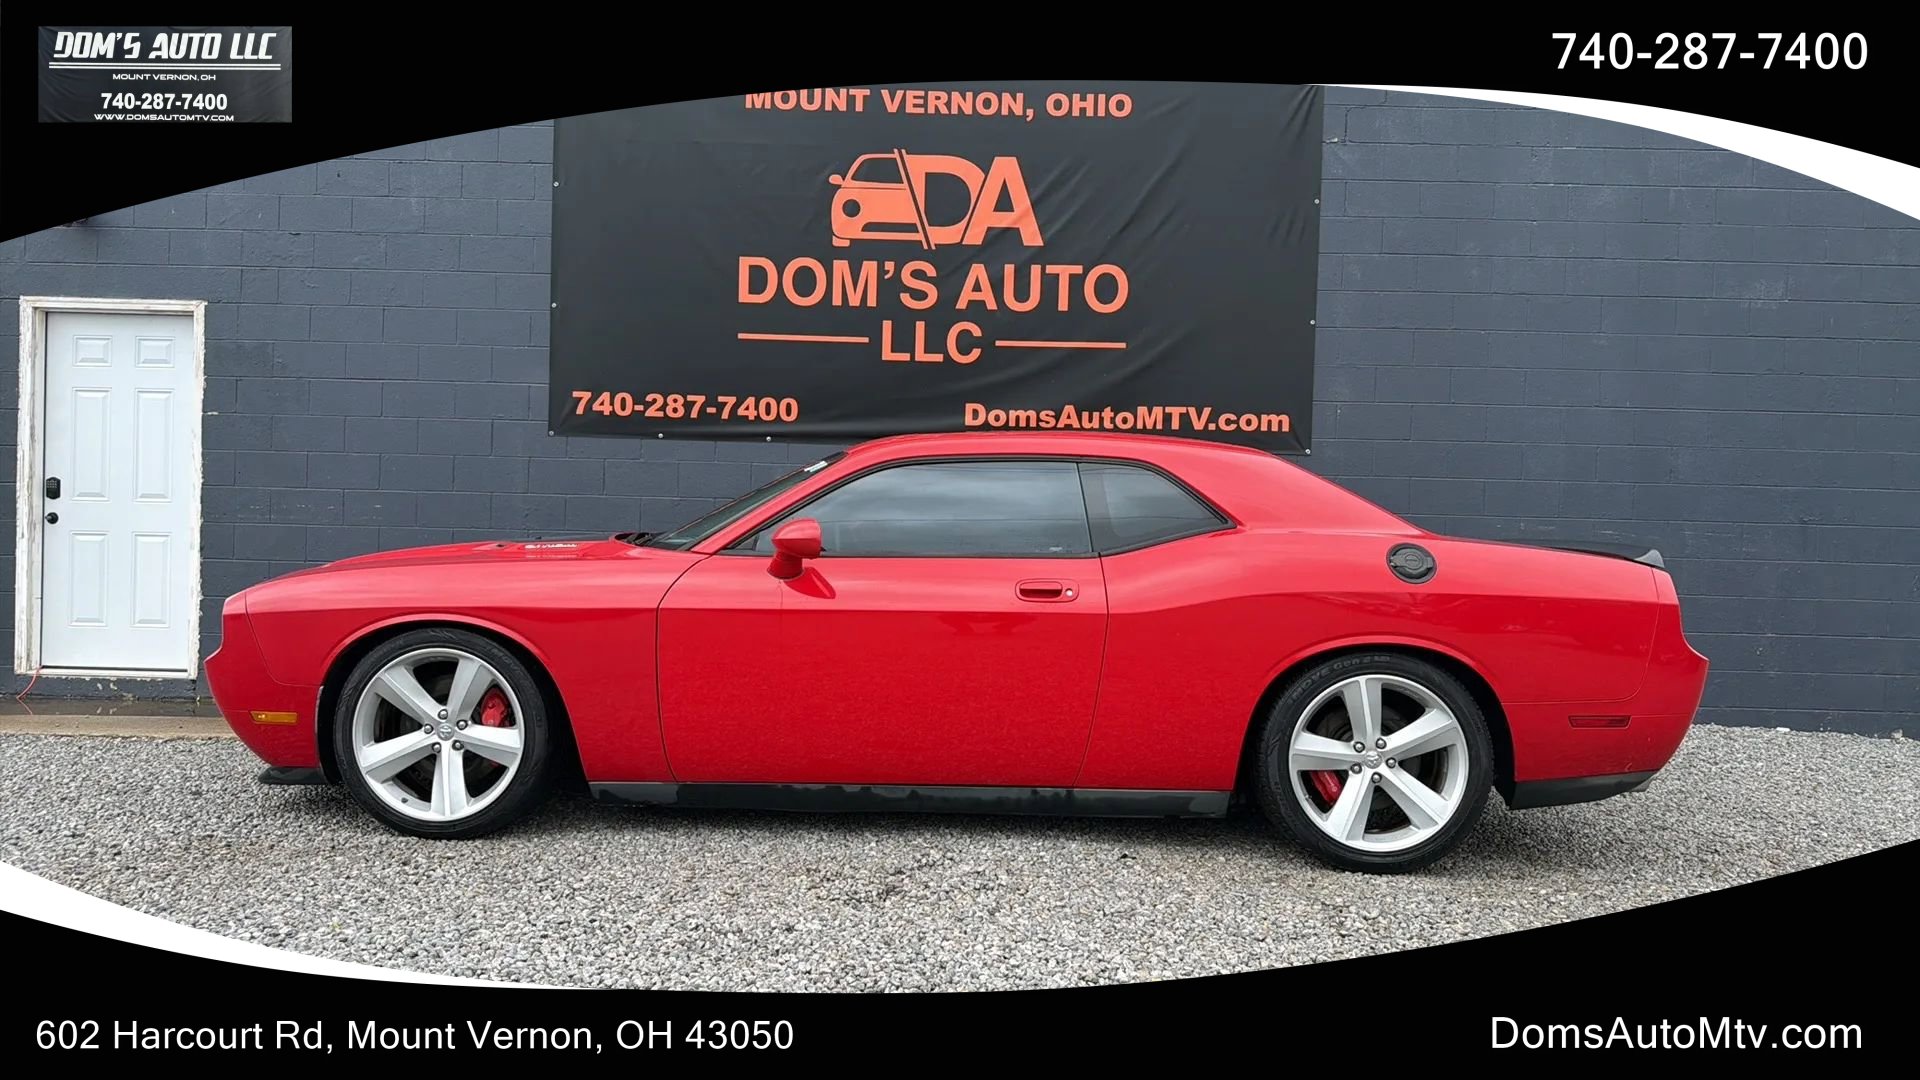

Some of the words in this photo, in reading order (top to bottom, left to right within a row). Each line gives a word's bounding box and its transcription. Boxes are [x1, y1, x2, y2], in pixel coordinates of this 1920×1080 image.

[745, 88, 871, 112] MOUNT
[880, 89, 1035, 121] VERNON,
[1046, 93, 1133, 118] OHIO
[738, 256, 939, 310] DOM'S
[956, 263, 1129, 314] AUTO
[881, 319, 983, 364] LLC
[572, 391, 799, 422] 740-287-7400
[964, 402, 1290, 433] DomsAutoMTV.com
